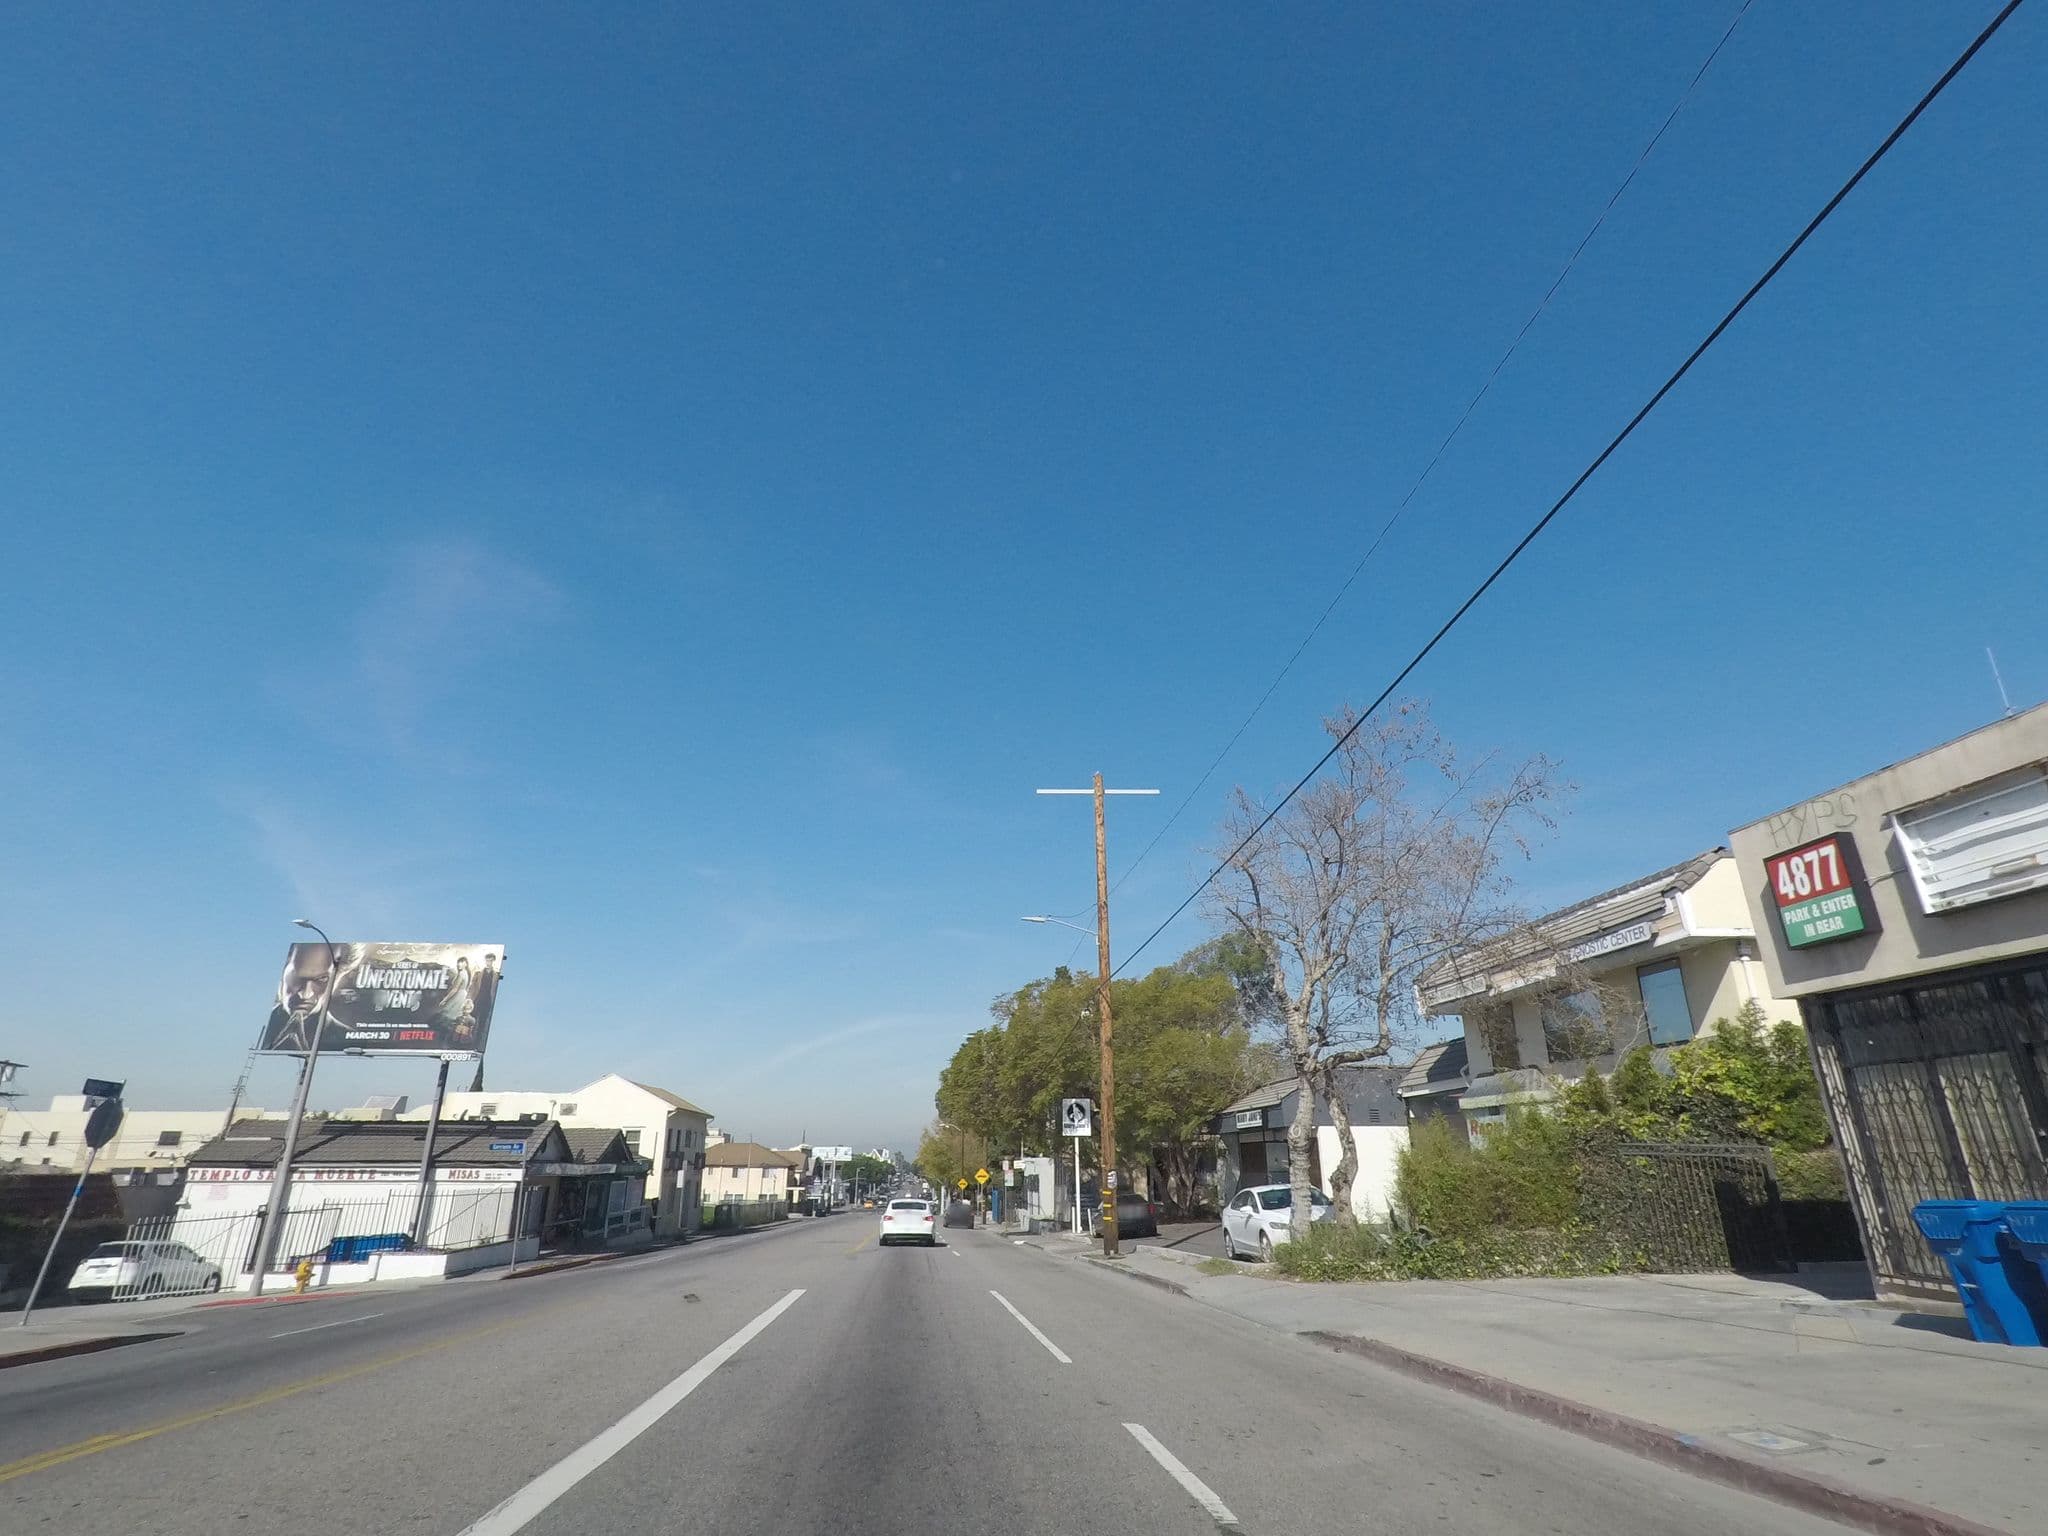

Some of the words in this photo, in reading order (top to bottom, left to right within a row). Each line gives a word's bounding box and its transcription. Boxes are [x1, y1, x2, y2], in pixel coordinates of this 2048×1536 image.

[1778, 844, 1840, 899] 4877
[1784, 905, 1810, 925] PARK
[1812, 904, 1820, 917] &
[1822, 894, 1856, 914] ENTER
[1611, 926, 1648, 947] CENTER
[1804, 924, 1815, 937] IN
[1817, 916, 1844, 934] REAR
[356, 965, 450, 990] UNFORTUNATE
[345, 1031, 377, 1040] MARCH
[379, 1031, 390, 1040] 30
[400, 1030, 434, 1041] NETFLIX
[440, 1053, 472, 1061] 000891
[190, 1169, 250, 1181] TEMPLO
[257, 1169, 306, 1181] SAA
[314, 1169, 377, 1181] MUERTE
[448, 1169, 480, 1180] MISAS
